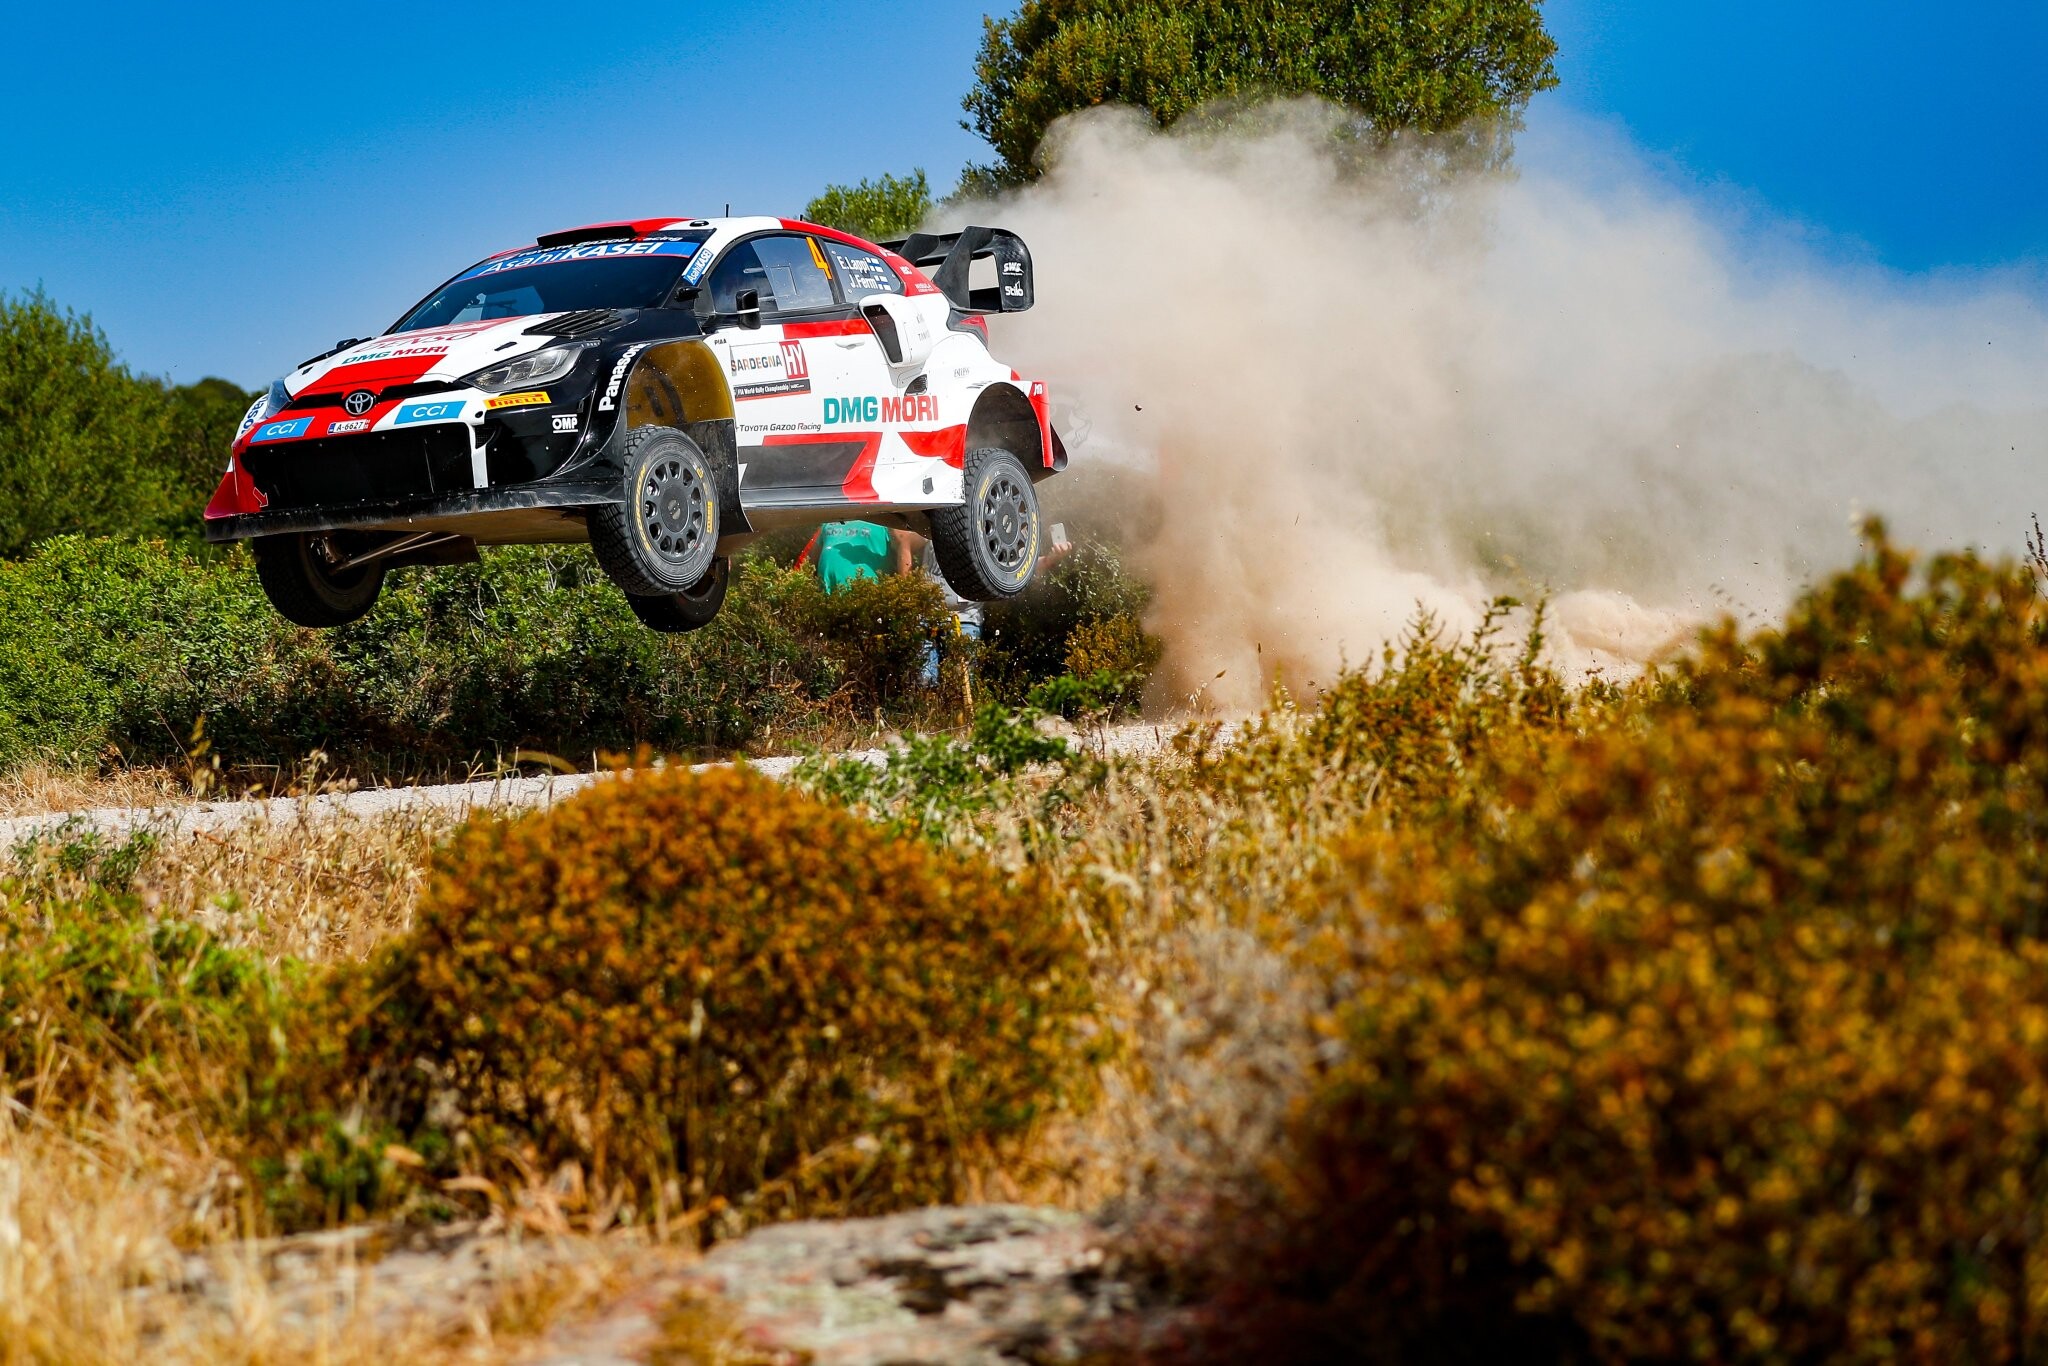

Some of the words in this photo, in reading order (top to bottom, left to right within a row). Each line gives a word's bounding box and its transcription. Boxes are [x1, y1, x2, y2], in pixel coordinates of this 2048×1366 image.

[478, 241, 665, 276] AsahiKASEI
[805, 236, 833, 280] 4
[341, 351, 390, 365] DMG
[391, 345, 450, 357] MORI
[730, 354, 783, 372] SARDEGNA
[489, 393, 546, 408] PIRELLI
[823, 396, 879, 425] DMG
[881, 395, 939, 423] MORI
[336, 421, 364, 432] A-6627
[552, 417, 578, 430] OMP
[739, 424, 768, 432] TOYOTA
[770, 423, 796, 431] GAZOO
[797, 421, 822, 432] Racing
